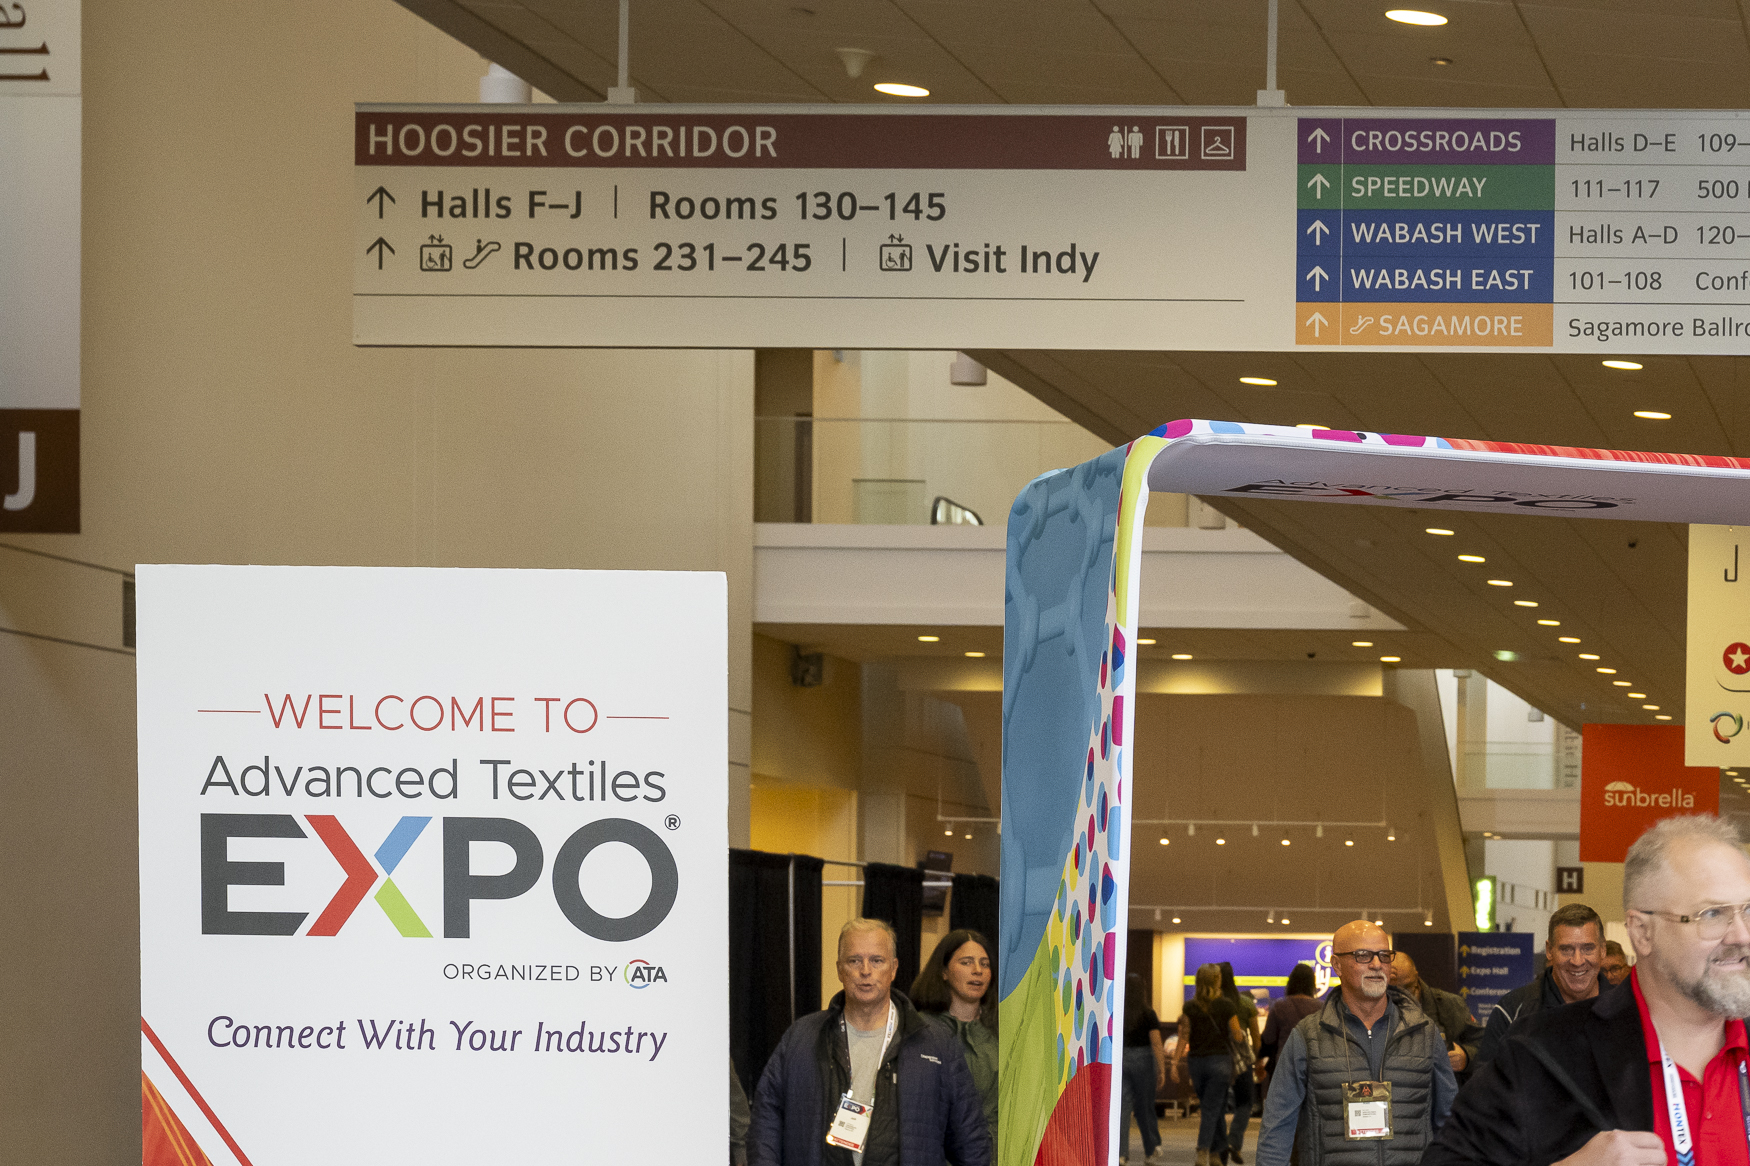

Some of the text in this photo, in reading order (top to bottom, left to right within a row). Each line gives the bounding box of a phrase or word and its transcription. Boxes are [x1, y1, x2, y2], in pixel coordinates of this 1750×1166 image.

[368, 123, 778, 158] HOOSIER CORRIDOR
[1351, 130, 1522, 152] CROSSROADS
[1570, 132, 1625, 153] Halls
[1633, 133, 1677, 153] D–E
[1351, 176, 1487, 198] SPEEDWAY
[1571, 179, 1660, 199] 111–117
[1697, 180, 1740, 200] 500
[421, 189, 947, 221] Halls F–J Rooms 130–145
[1351, 222, 1541, 245] WABASH WEST
[1569, 224, 1624, 245] Halls
[1632, 225, 1679, 245] A–D
[514, 242, 1100, 283] Rooms 231–245 Visit Indy
[1351, 268, 1534, 291] WABASH EAST
[1569, 271, 1663, 291] 101–108
[1379, 315, 1523, 337] SAGAMORE
[1568, 318, 1684, 342] Sagamore
[3, 431, 36, 511] J
[264, 693, 599, 734] WELCOME TO
[200, 755, 667, 803] Advanced Textiles
[1604, 788, 1694, 808] sunbrella
[1562, 871, 1578, 890] H
[1471, 946, 1521, 956] Registration
[443, 963, 668, 983] ORGANIZED BY ATA
[1471, 966, 1509, 976] Expo Hall
[206, 1016, 668, 1062] Connect With Your Industry
